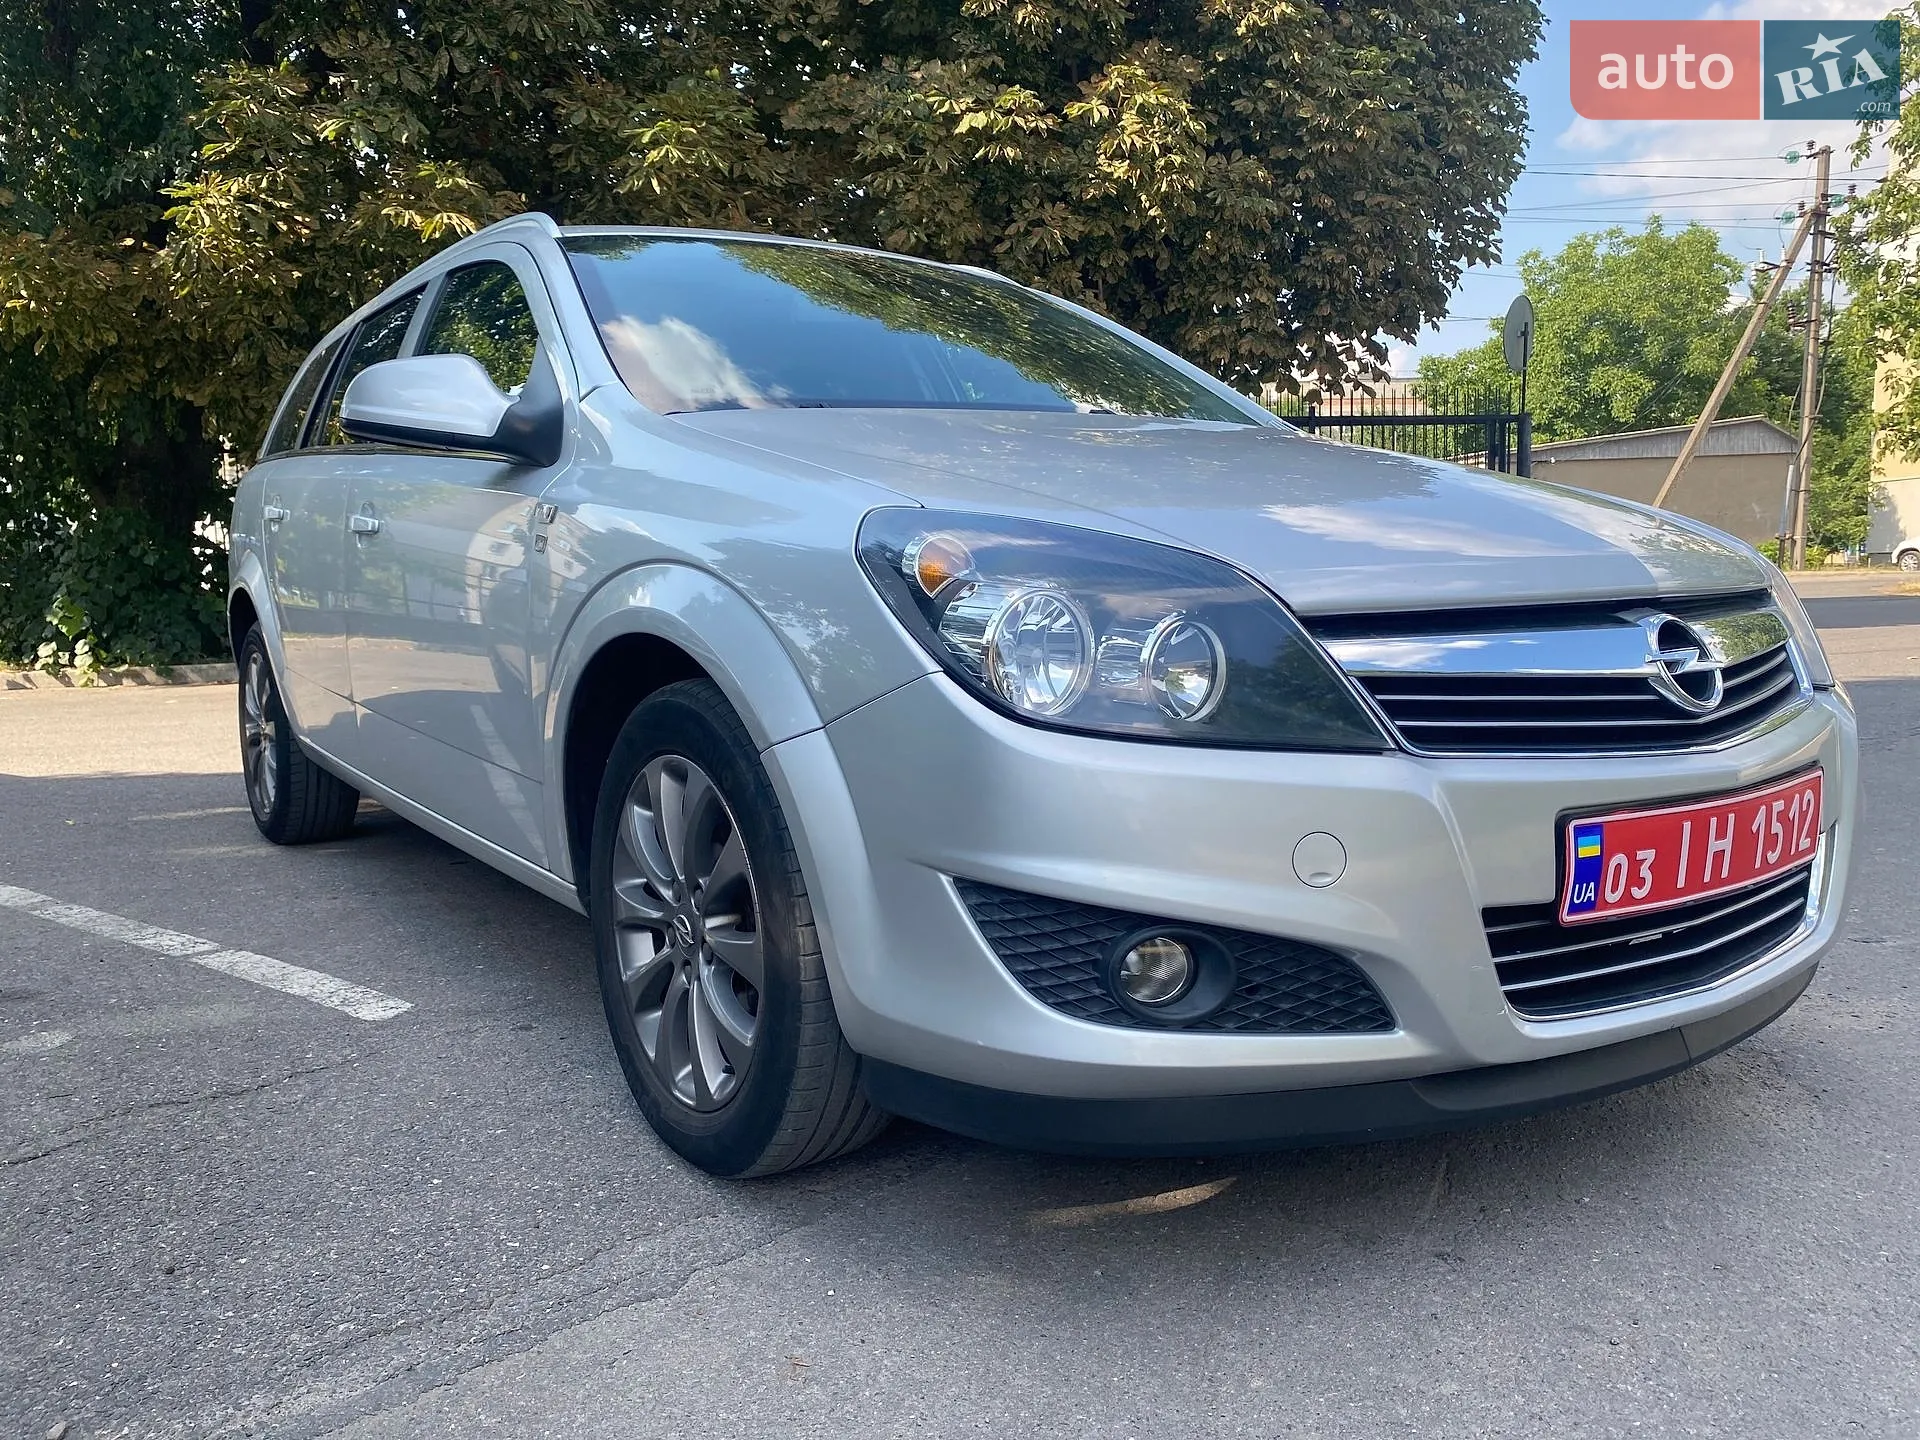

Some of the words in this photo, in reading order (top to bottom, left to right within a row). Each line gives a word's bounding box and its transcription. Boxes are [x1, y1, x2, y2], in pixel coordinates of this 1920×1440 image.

[1604, 849, 1656, 904] 03
[1751, 789, 1815, 869] 1512
[1574, 881, 1595, 904] UA
